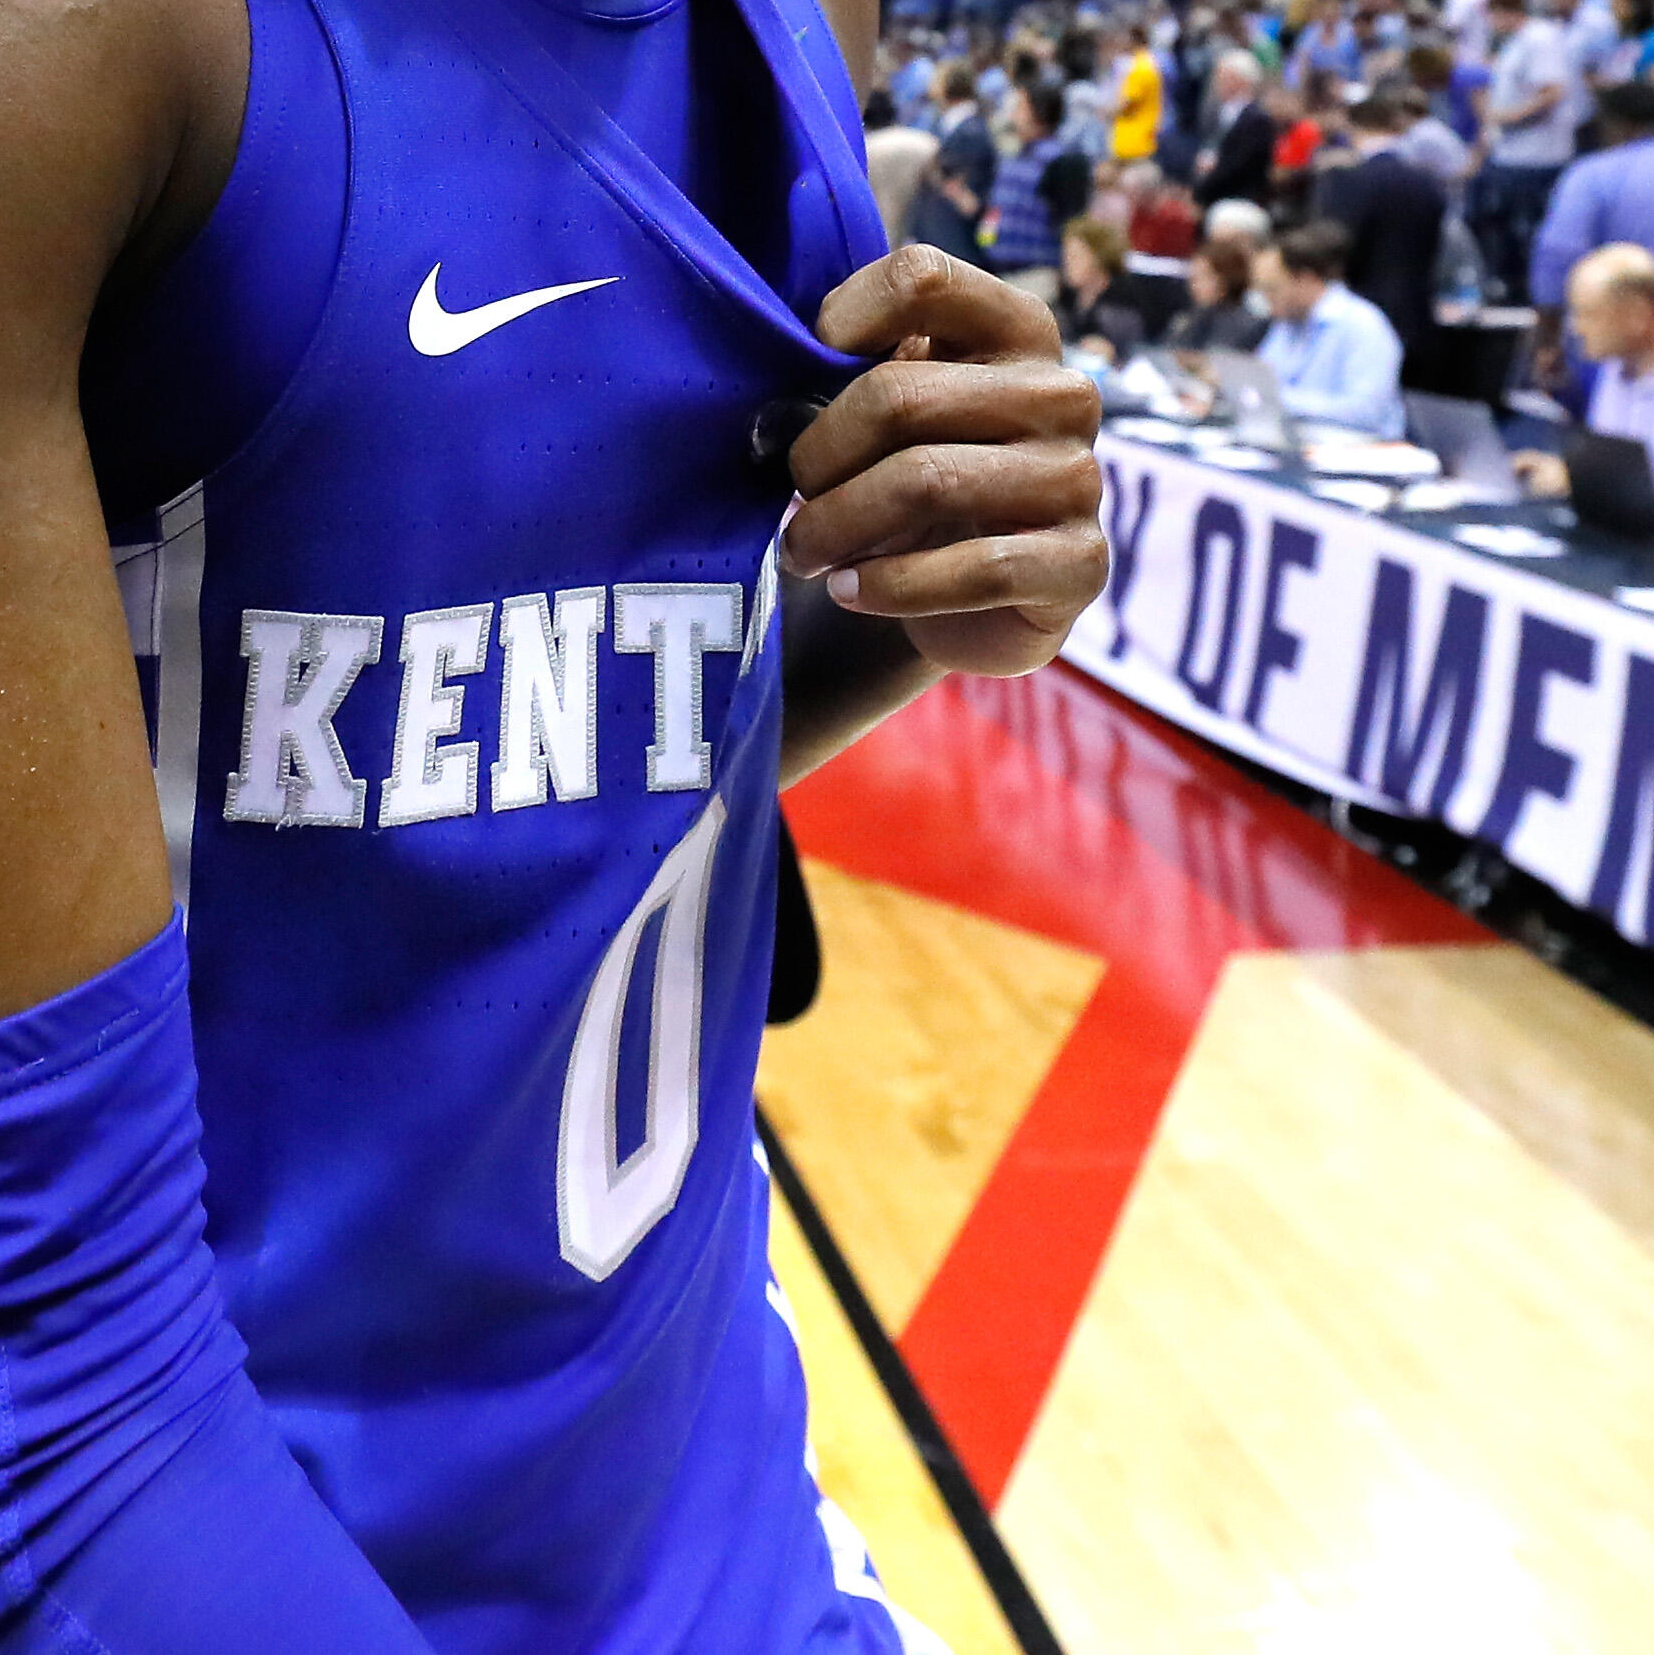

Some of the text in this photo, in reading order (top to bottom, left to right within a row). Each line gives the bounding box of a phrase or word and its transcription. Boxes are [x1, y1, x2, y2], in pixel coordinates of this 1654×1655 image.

[224, 541, 778, 830] KENT
[1106, 462, 1154, 660] Y
[1177, 497, 1322, 728] OF
[557, 798, 727, 1283] 0
